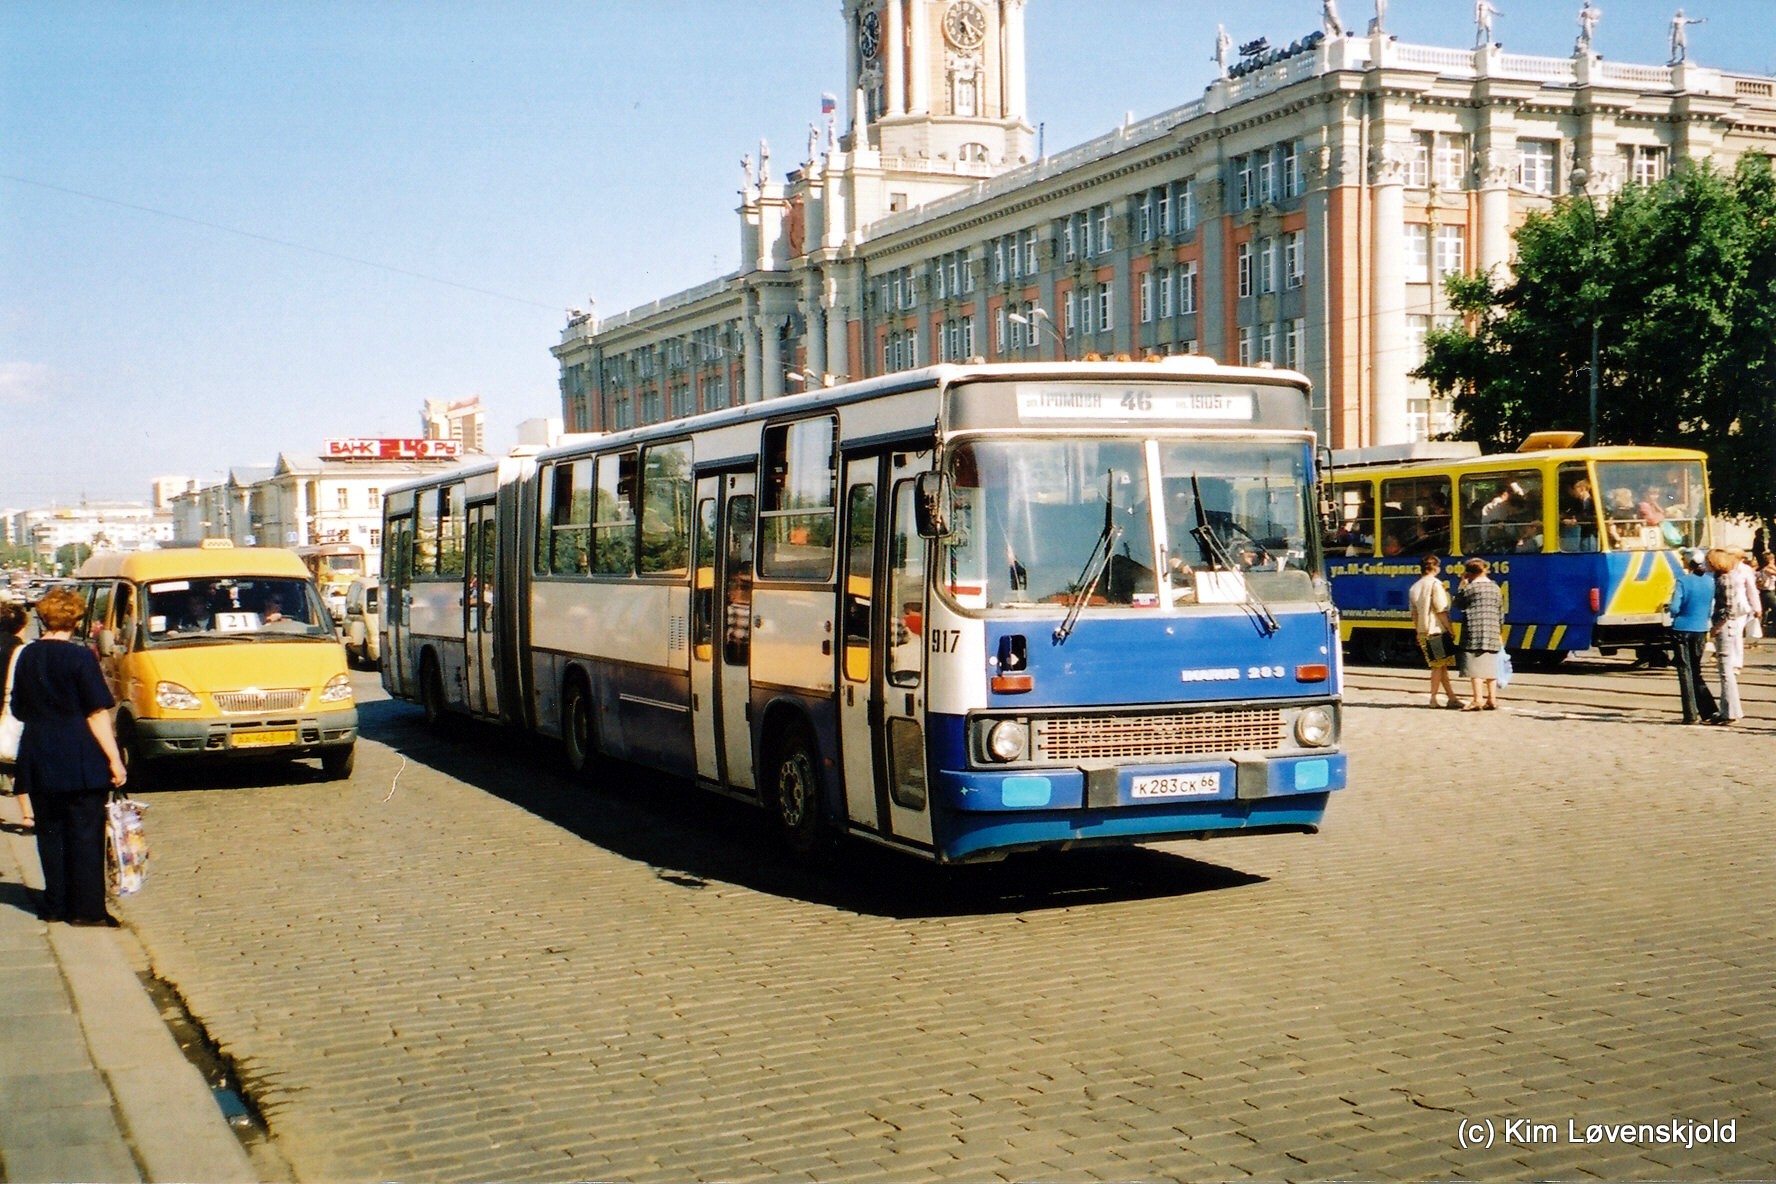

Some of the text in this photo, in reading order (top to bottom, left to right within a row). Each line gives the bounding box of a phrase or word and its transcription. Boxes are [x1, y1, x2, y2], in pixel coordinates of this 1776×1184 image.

[1121, 390, 1152, 411] 46
[1190, 394, 1222, 409] 1905
[330, 441, 374, 455] БАНК
[225, 614, 249, 628] 21
[932, 629, 960, 653] 917
